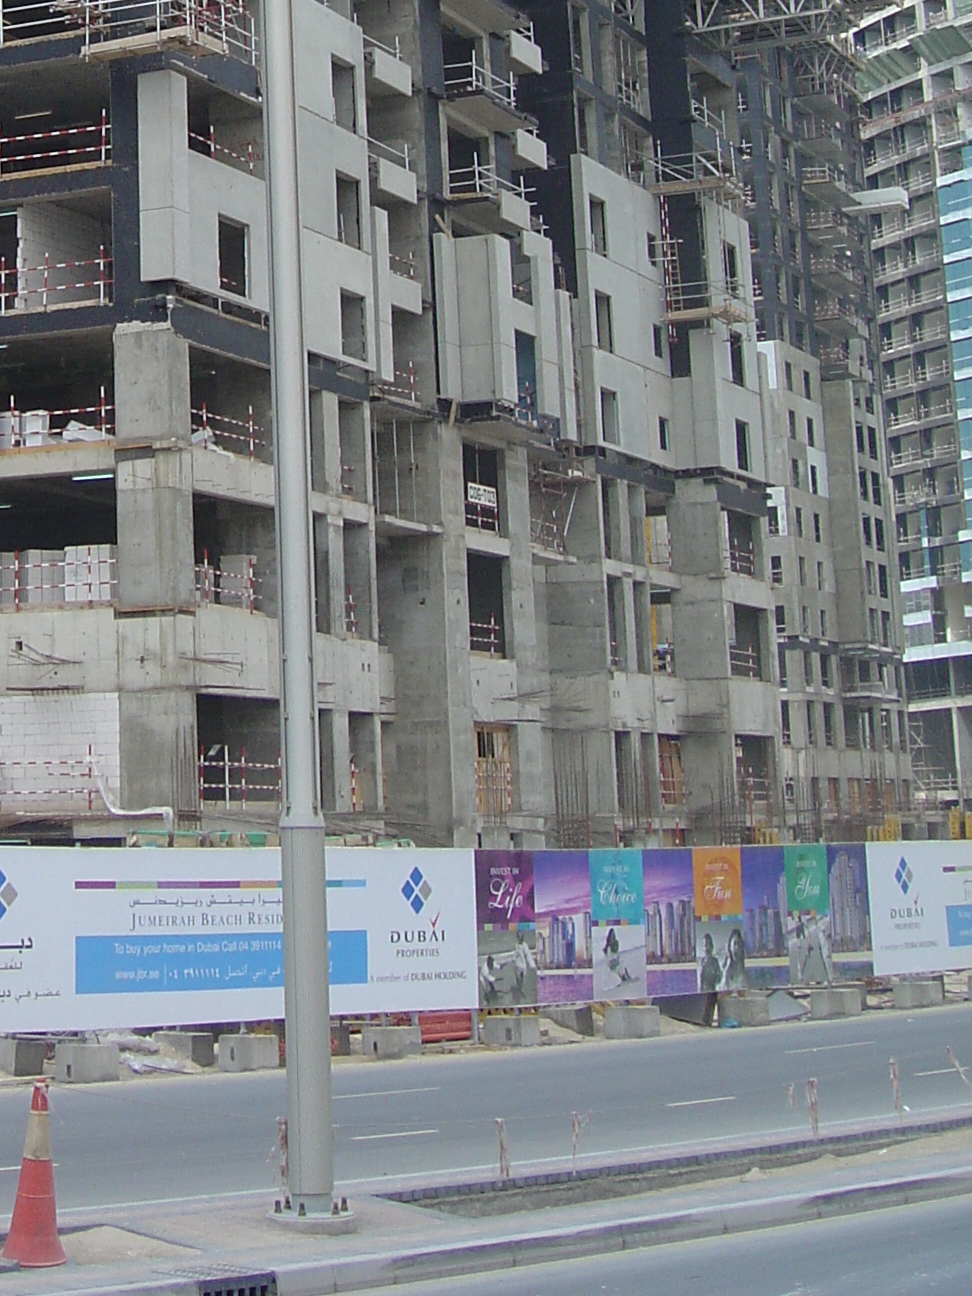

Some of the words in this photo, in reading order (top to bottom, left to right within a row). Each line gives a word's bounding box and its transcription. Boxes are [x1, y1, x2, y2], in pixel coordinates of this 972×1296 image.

[597, 879, 637, 903] Choice
[704, 876, 732, 900] Fun
[488, 878, 523, 919] Life
[130, 912, 196, 931] JUMEIRAH
[201, 912, 242, 926] BEACH
[248, 911, 283, 925] RESID
[890, 907, 924, 919] DUBAI
[390, 930, 445, 943] DUBAI
[114, 943, 124, 954] To
[126, 943, 141, 956] buy
[143, 944, 161, 956] your
[163, 942, 186, 953] home
[187, 942, 195, 952] in
[196, 941, 219, 952] Dubai
[222, 940, 237, 952] Call
[239, 941, 248, 951] 04
[396, 948, 439, 958] PROPERTIES
